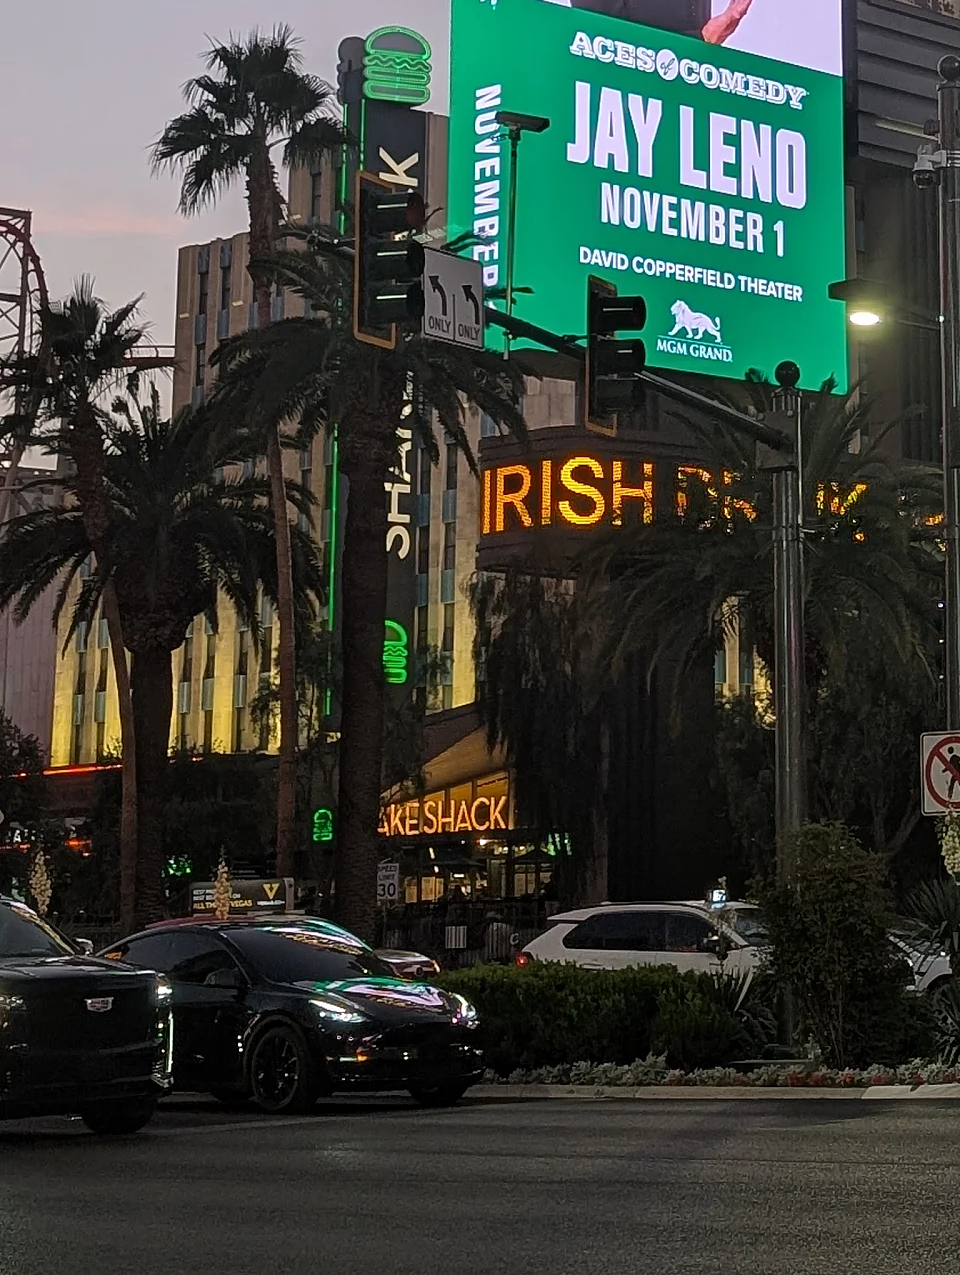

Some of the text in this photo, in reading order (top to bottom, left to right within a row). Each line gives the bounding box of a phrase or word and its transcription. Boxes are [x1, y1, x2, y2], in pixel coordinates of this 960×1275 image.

[569, 31, 657, 73] ACES
[679, 59, 808, 110] COMEDY
[566, 81, 807, 209] JAY LENO
[600, 182, 785, 257] NOVEMBER 1
[579, 246, 803, 302] DAVID COPPERFIELD THEATER
[428, 315, 451, 333] ONLY
[458, 323, 480, 341] ONLY
[656, 338, 732, 362] MGM GRAND
[482, 456, 653, 534] IRISH
[377, 796, 508, 836] AKE SHACK
[377, 883, 396, 897] 30
